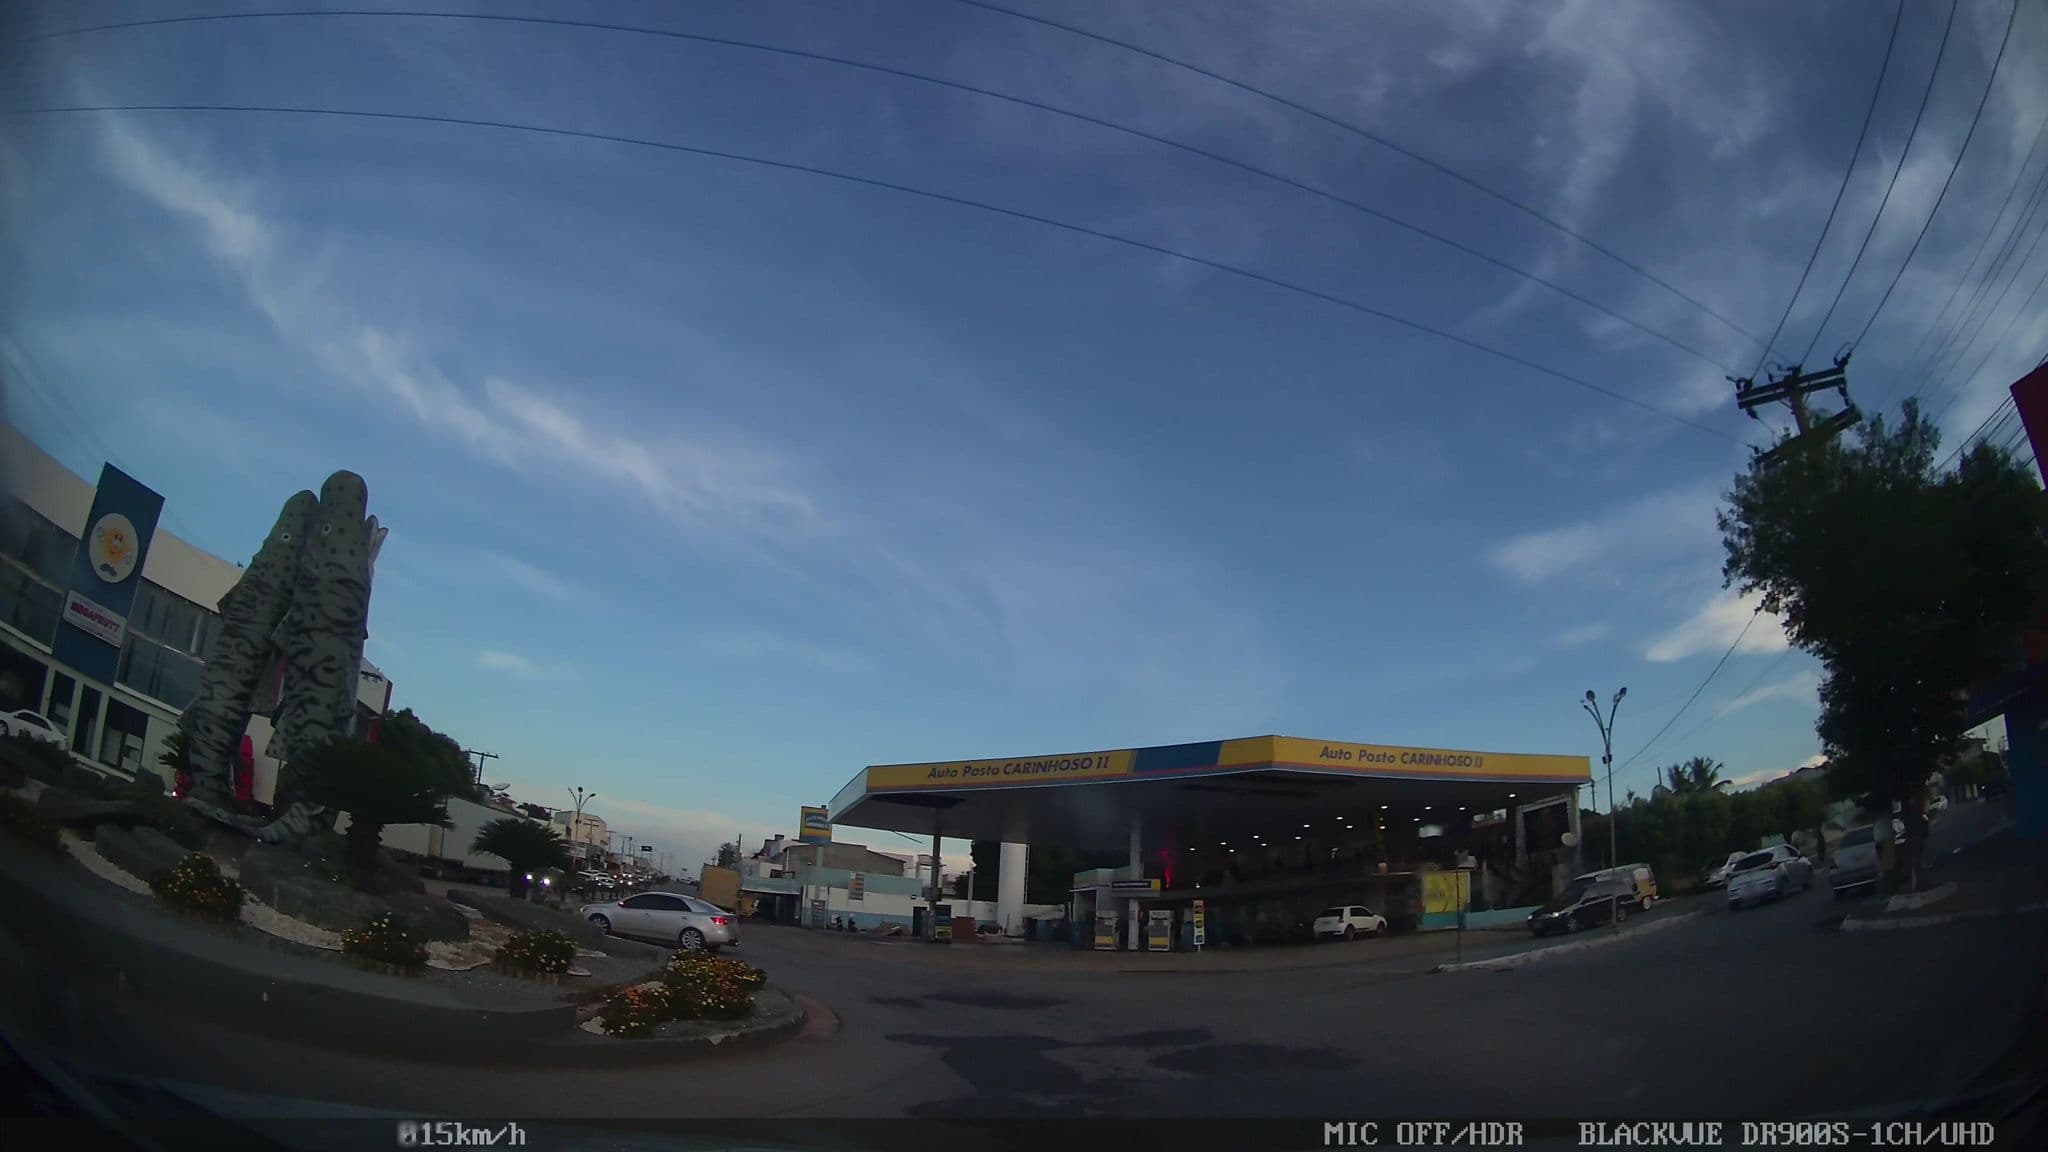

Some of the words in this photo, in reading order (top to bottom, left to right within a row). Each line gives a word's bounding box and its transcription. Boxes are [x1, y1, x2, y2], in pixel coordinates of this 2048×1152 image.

[1319, 746, 1352, 761] Auto
[1358, 749, 1396, 764] Posto
[1400, 752, 1473, 768] CARINHOSO
[928, 767, 958, 780] Auto
[962, 765, 1000, 778] Posto
[1003, 757, 1094, 776] CARINHOSO
